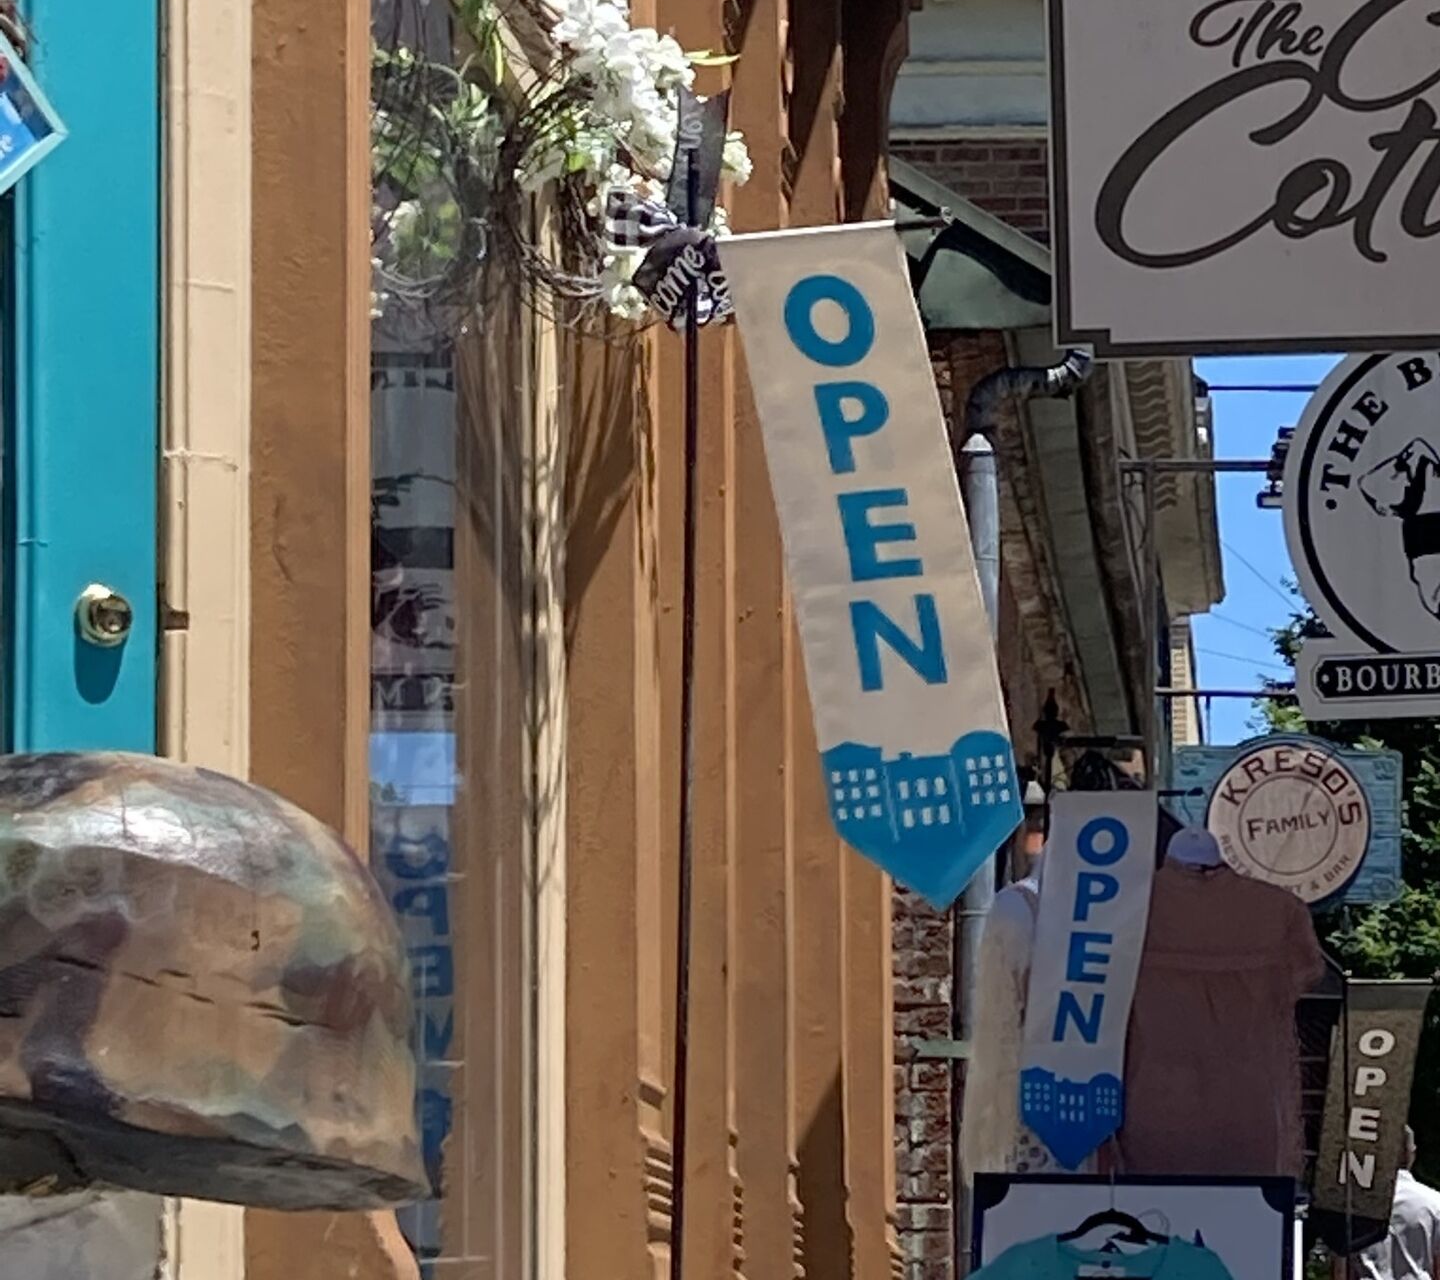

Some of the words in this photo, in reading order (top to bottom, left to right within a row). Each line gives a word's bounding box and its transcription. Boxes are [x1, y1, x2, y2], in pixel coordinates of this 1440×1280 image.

[783, 274, 949, 693] OPEN
[1319, 391, 1389, 492] THE
[1220, 749, 1362, 825] KRESO'S
[1246, 809, 1330, 842] FAMILY
[1051, 816, 1130, 1045] OPEN
[1337, 1028, 1396, 1190] OPEN
